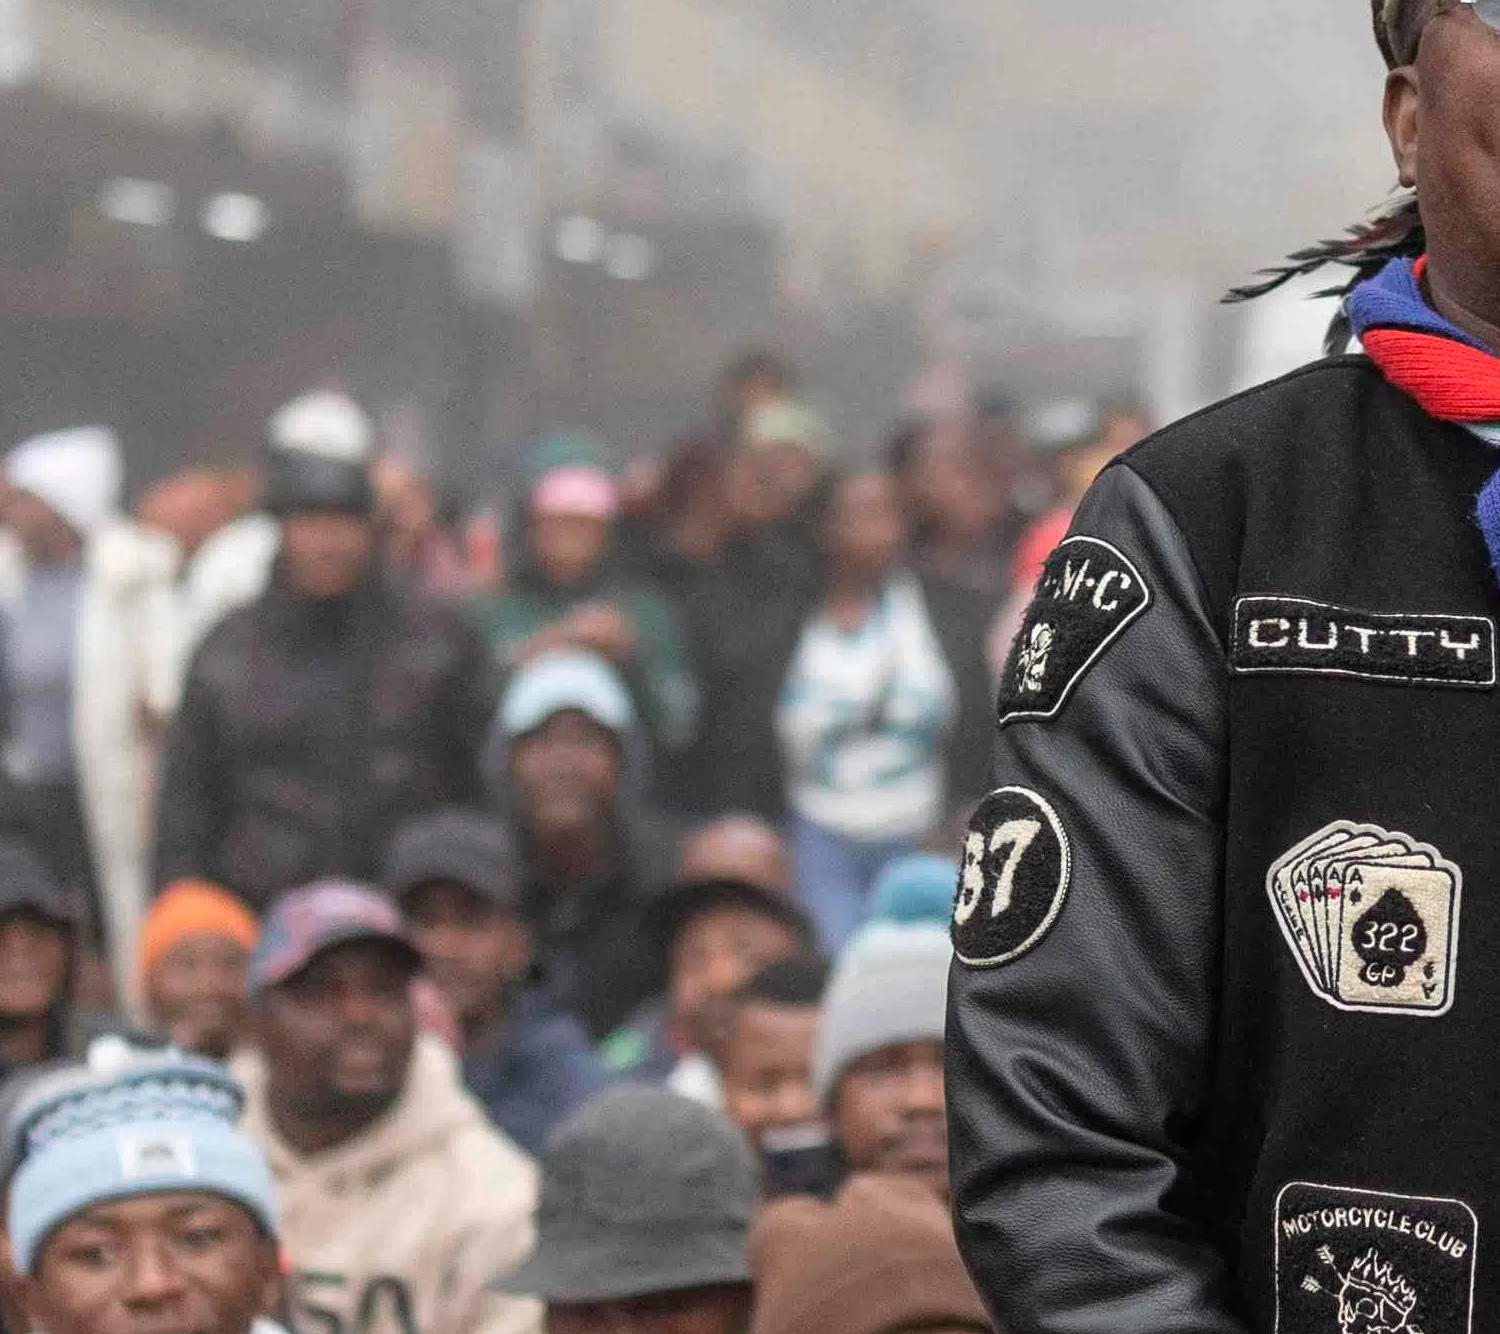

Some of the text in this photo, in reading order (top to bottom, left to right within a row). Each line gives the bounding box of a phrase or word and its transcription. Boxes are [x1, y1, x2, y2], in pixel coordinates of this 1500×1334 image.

[1249, 618, 1479, 660] CUTTY
[1348, 868, 1364, 885] A
[1282, 1206, 1467, 1259] MOTORCYCLE CLUB
